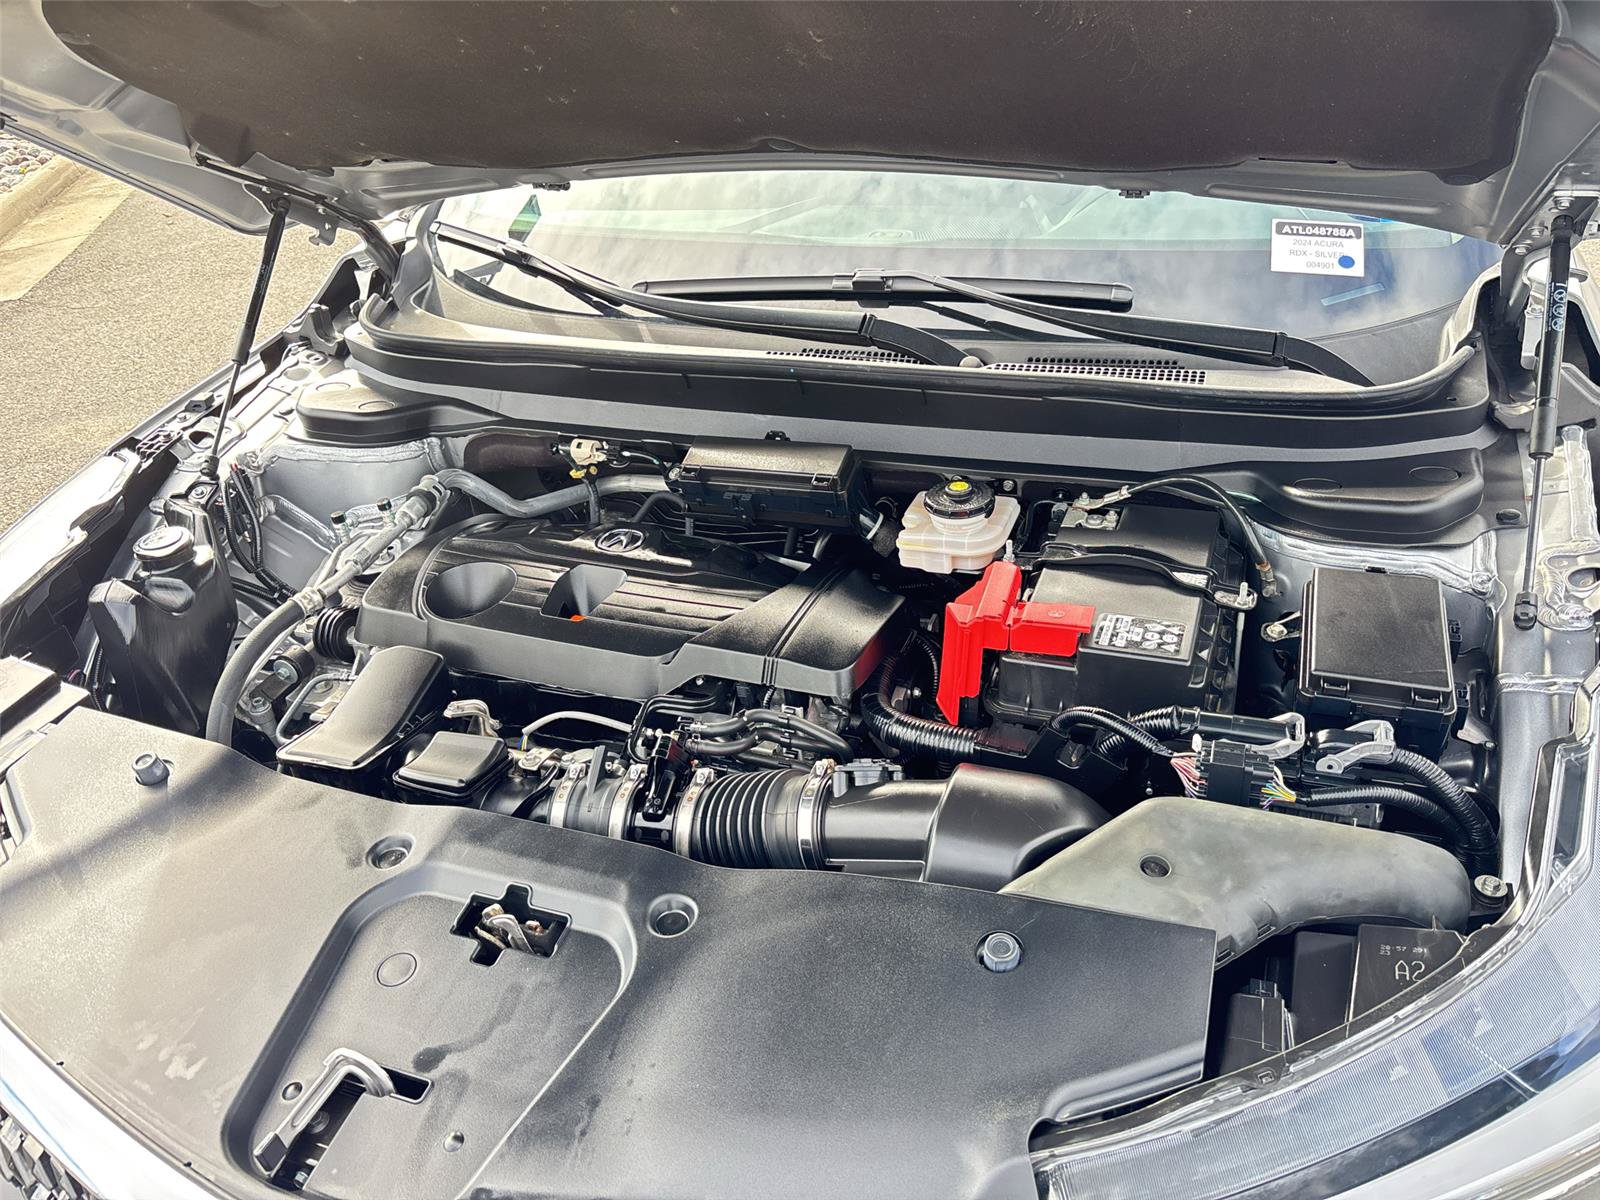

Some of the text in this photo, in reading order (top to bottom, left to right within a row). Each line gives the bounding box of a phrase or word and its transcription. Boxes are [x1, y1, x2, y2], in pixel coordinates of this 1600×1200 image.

[1293, 238, 1344, 248] 2024 ACURA
[1289, 249, 1308, 257] RDX
[1395, 959, 1425, 982] A2
